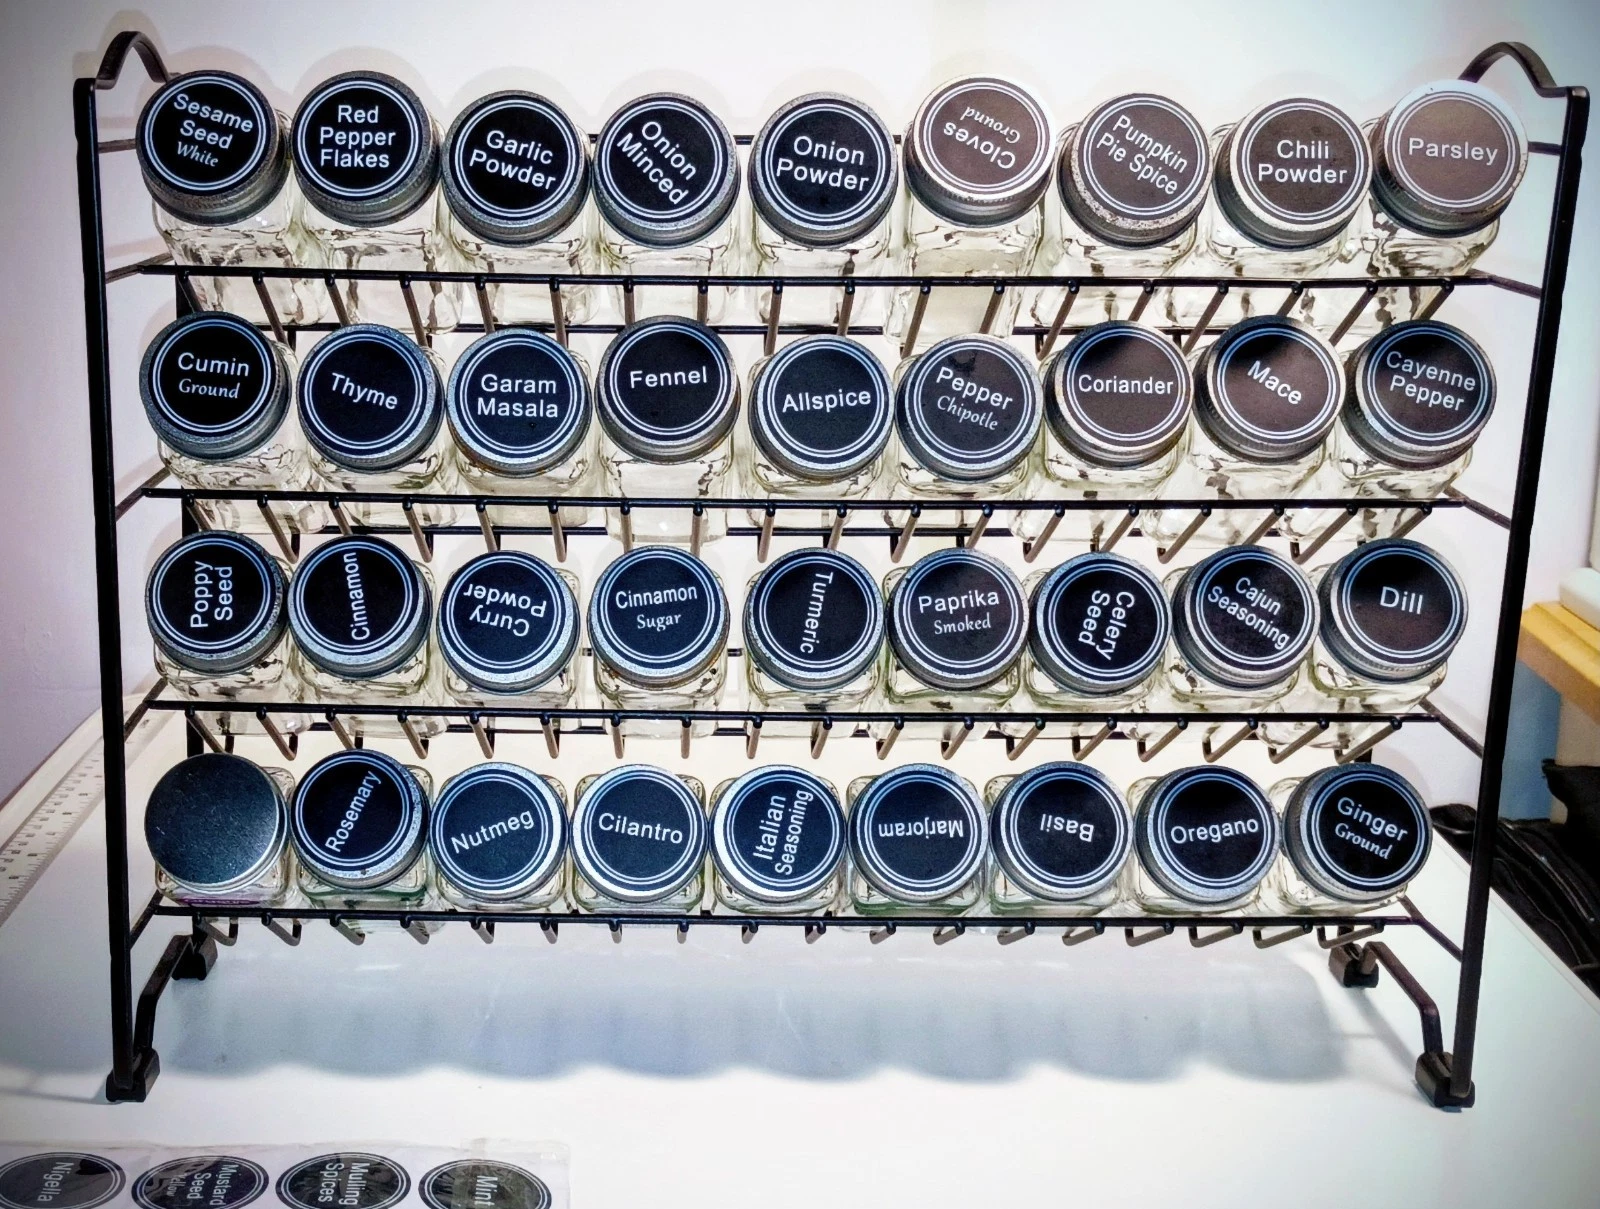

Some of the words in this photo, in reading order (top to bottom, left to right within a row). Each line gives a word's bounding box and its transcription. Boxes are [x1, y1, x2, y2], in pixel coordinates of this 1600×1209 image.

[173, 93, 253, 132] Sesame
[338, 104, 379, 124] Red
[960, 106, 1020, 143] Ground
[180, 119, 233, 149] Seed
[320, 126, 396, 150] Pepper
[486, 130, 553, 164] Garlic
[641, 121, 696, 181] Onion
[793, 135, 865, 166] Onion
[943, 122, 1016, 169] Cloves
[1112, 114, 1187, 173] Pumpkin
[1277, 139, 1329, 159] Chili
[1409, 138, 1498, 165] Parsley
[177, 141, 219, 167] White
[320, 148, 390, 168] Flakes
[469, 148, 556, 190] Powder
[616, 132, 689, 205] Minced
[1096, 132, 1126, 162] Pie
[1129, 153, 1178, 194] Spice
[776, 157, 870, 191] Powder
[1258, 163, 1348, 184] Powder
[178, 352, 249, 377] Cumin
[630, 365, 707, 389] Fennel
[1247, 360, 1302, 404] Mace
[1387, 351, 1476, 391] Cayenne
[179, 378, 240, 399] Ground
[332, 372, 398, 410] Thyme
[481, 373, 557, 394] Garam
[782, 388, 871, 413] Allspice
[936, 366, 1013, 410] Pepper
[1078, 374, 1174, 395] Coriander
[1390, 374, 1465, 411] Pepper
[477, 397, 558, 418] Masala
[937, 395, 998, 430] Chipotle
[190, 561, 213, 628] Poppy
[214, 566, 233, 621] Seed
[343, 552, 370, 641] Cinnamon
[463, 583, 547, 618] Powder
[615, 586, 698, 609] Cinnamon
[918, 589, 1000, 614] Paprika
[1236, 577, 1281, 616] Cajun
[1380, 586, 1423, 615] Dill
[469, 604, 530, 637] Curry
[636, 614, 682, 632] Sugar
[800, 571, 834, 654] Turmeric
[934, 612, 991, 635] Smoked
[1078, 590, 1111, 646] Seed
[1095, 591, 1135, 661] Celery
[1208, 586, 1290, 650] Seasoning
[325, 771, 381, 852] Rosemary
[598, 812, 683, 844] Cilantro
[752, 795, 786, 860] Italian
[878, 816, 964, 839] Marjoram
[1040, 813, 1094, 843] Basil
[1337, 797, 1408, 841] Ginger
[450, 810, 534, 854] Nutmeg
[774, 790, 814, 875] Seasoning
[1170, 818, 1259, 844] Oregano
[1335, 823, 1393, 859] Ground
[37, 1162, 75, 1202] Nigella
[187, 1172, 212, 1199] Seed
[209, 1164, 239, 1206] Mustard
[318, 1162, 345, 1202] Spices
[338, 1162, 370, 1206] Mulling
[473, 1175, 498, 1206] Mint
